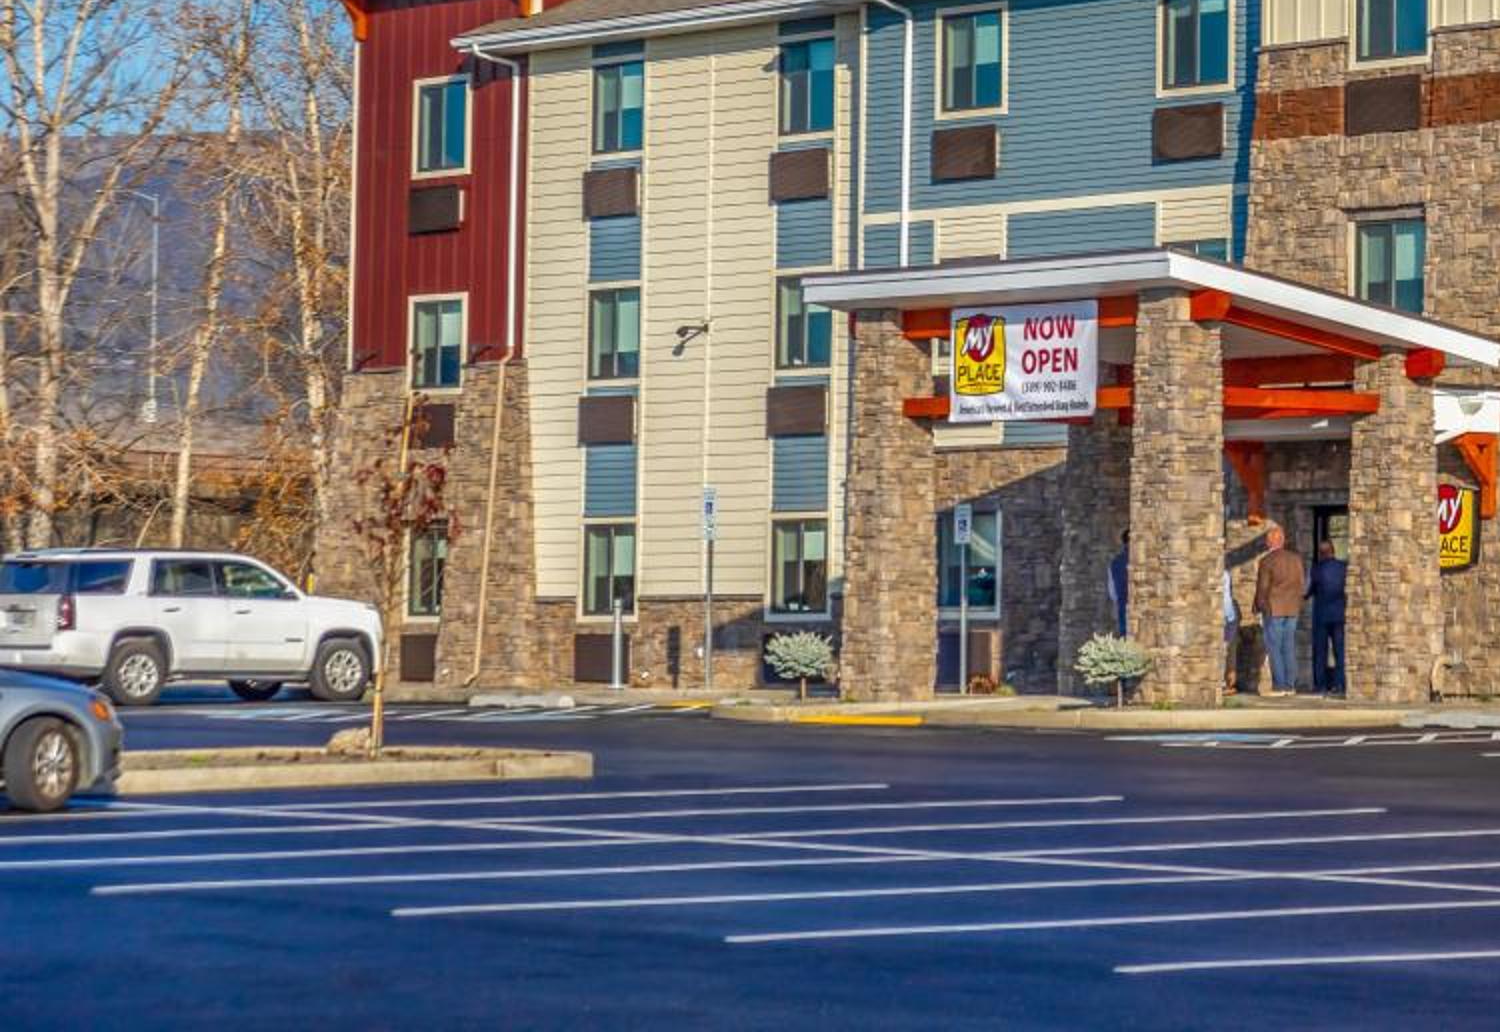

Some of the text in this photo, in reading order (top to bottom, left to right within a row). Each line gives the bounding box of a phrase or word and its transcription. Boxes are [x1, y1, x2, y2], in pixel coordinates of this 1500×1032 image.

[1023, 314, 1076, 341] NOW
[1021, 347, 1079, 375] OPEN
[958, 363, 1001, 383] PLACE
[1440, 535, 1469, 553] ACE
